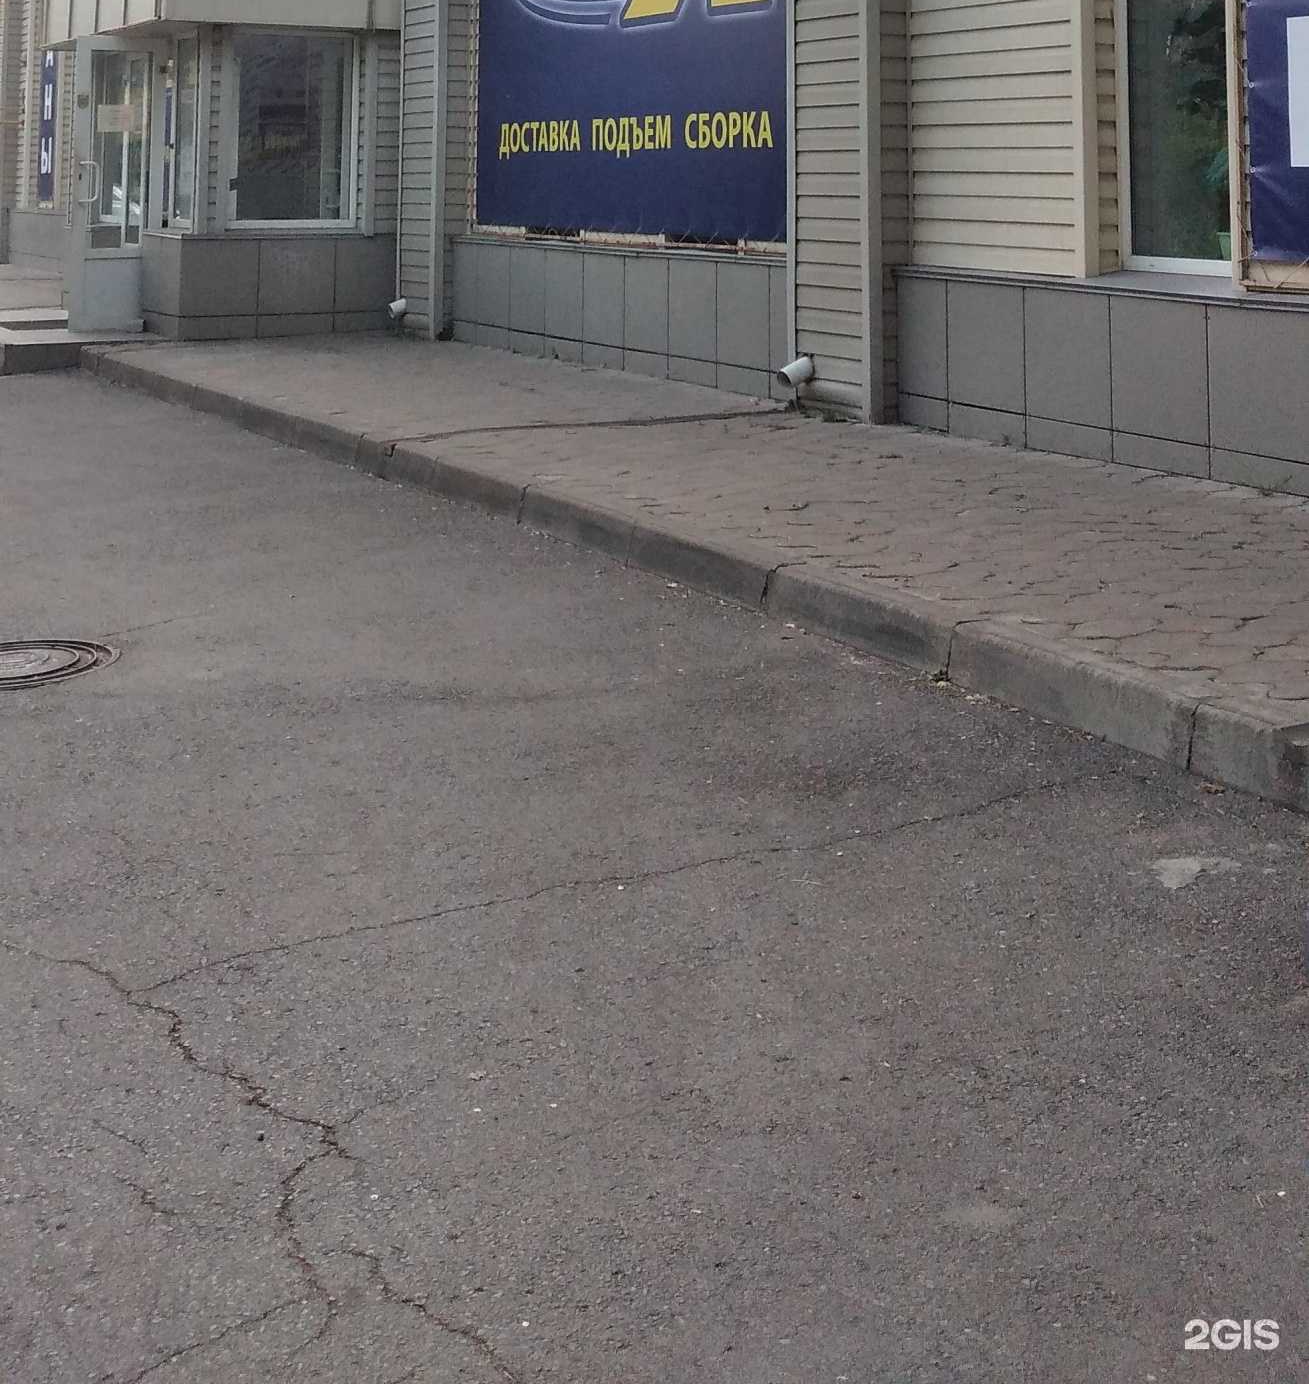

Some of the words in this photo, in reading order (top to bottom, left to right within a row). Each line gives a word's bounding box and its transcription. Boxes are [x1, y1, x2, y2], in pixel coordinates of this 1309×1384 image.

[499, 119, 581, 159] ДОСТАВКА
[591, 115, 672, 158] ПОДЪЕМ
[684, 111, 773, 150] СБОРКА
